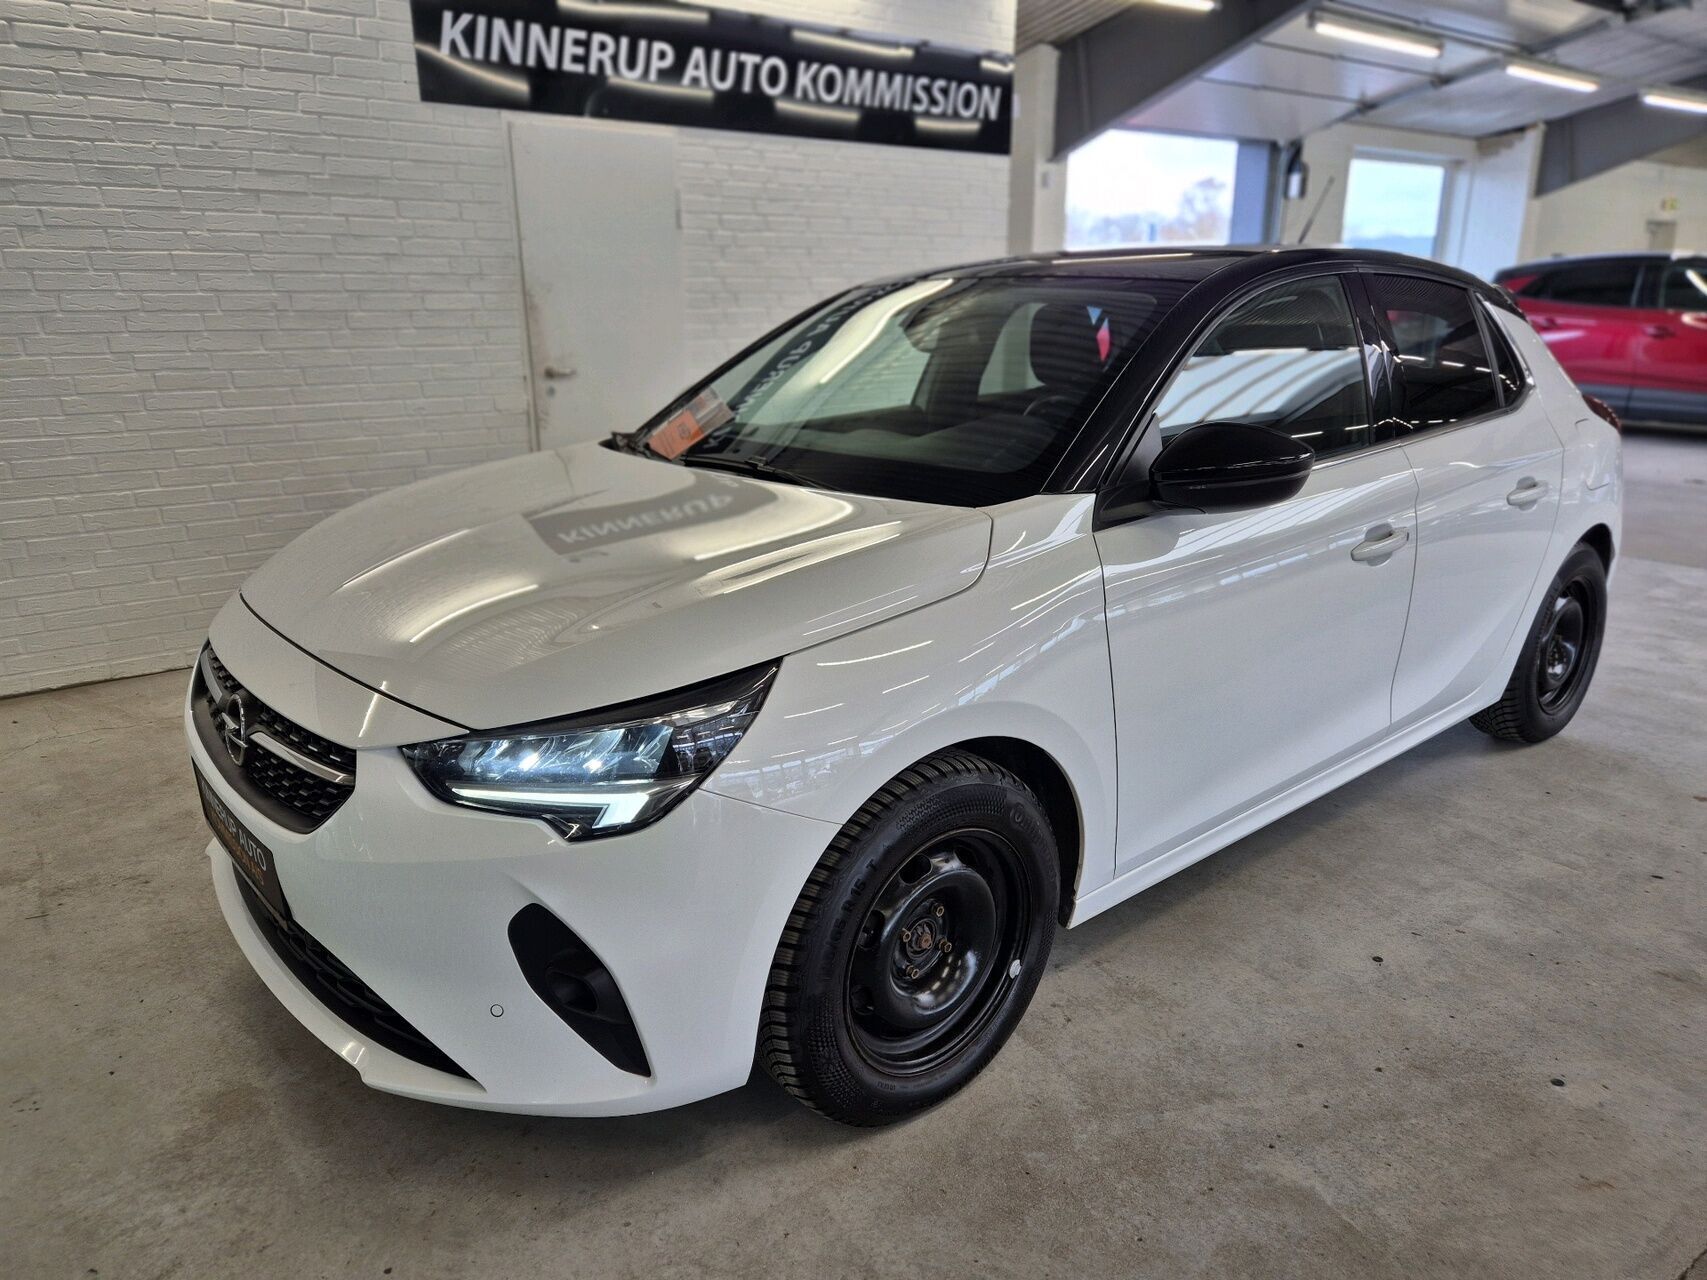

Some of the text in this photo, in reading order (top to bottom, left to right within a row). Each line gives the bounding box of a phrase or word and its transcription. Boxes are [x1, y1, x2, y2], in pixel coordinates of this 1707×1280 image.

[439, 10, 1002, 121] KINNERUP AUTO KOMMISSION
[238, 829, 268, 872] AUTO
